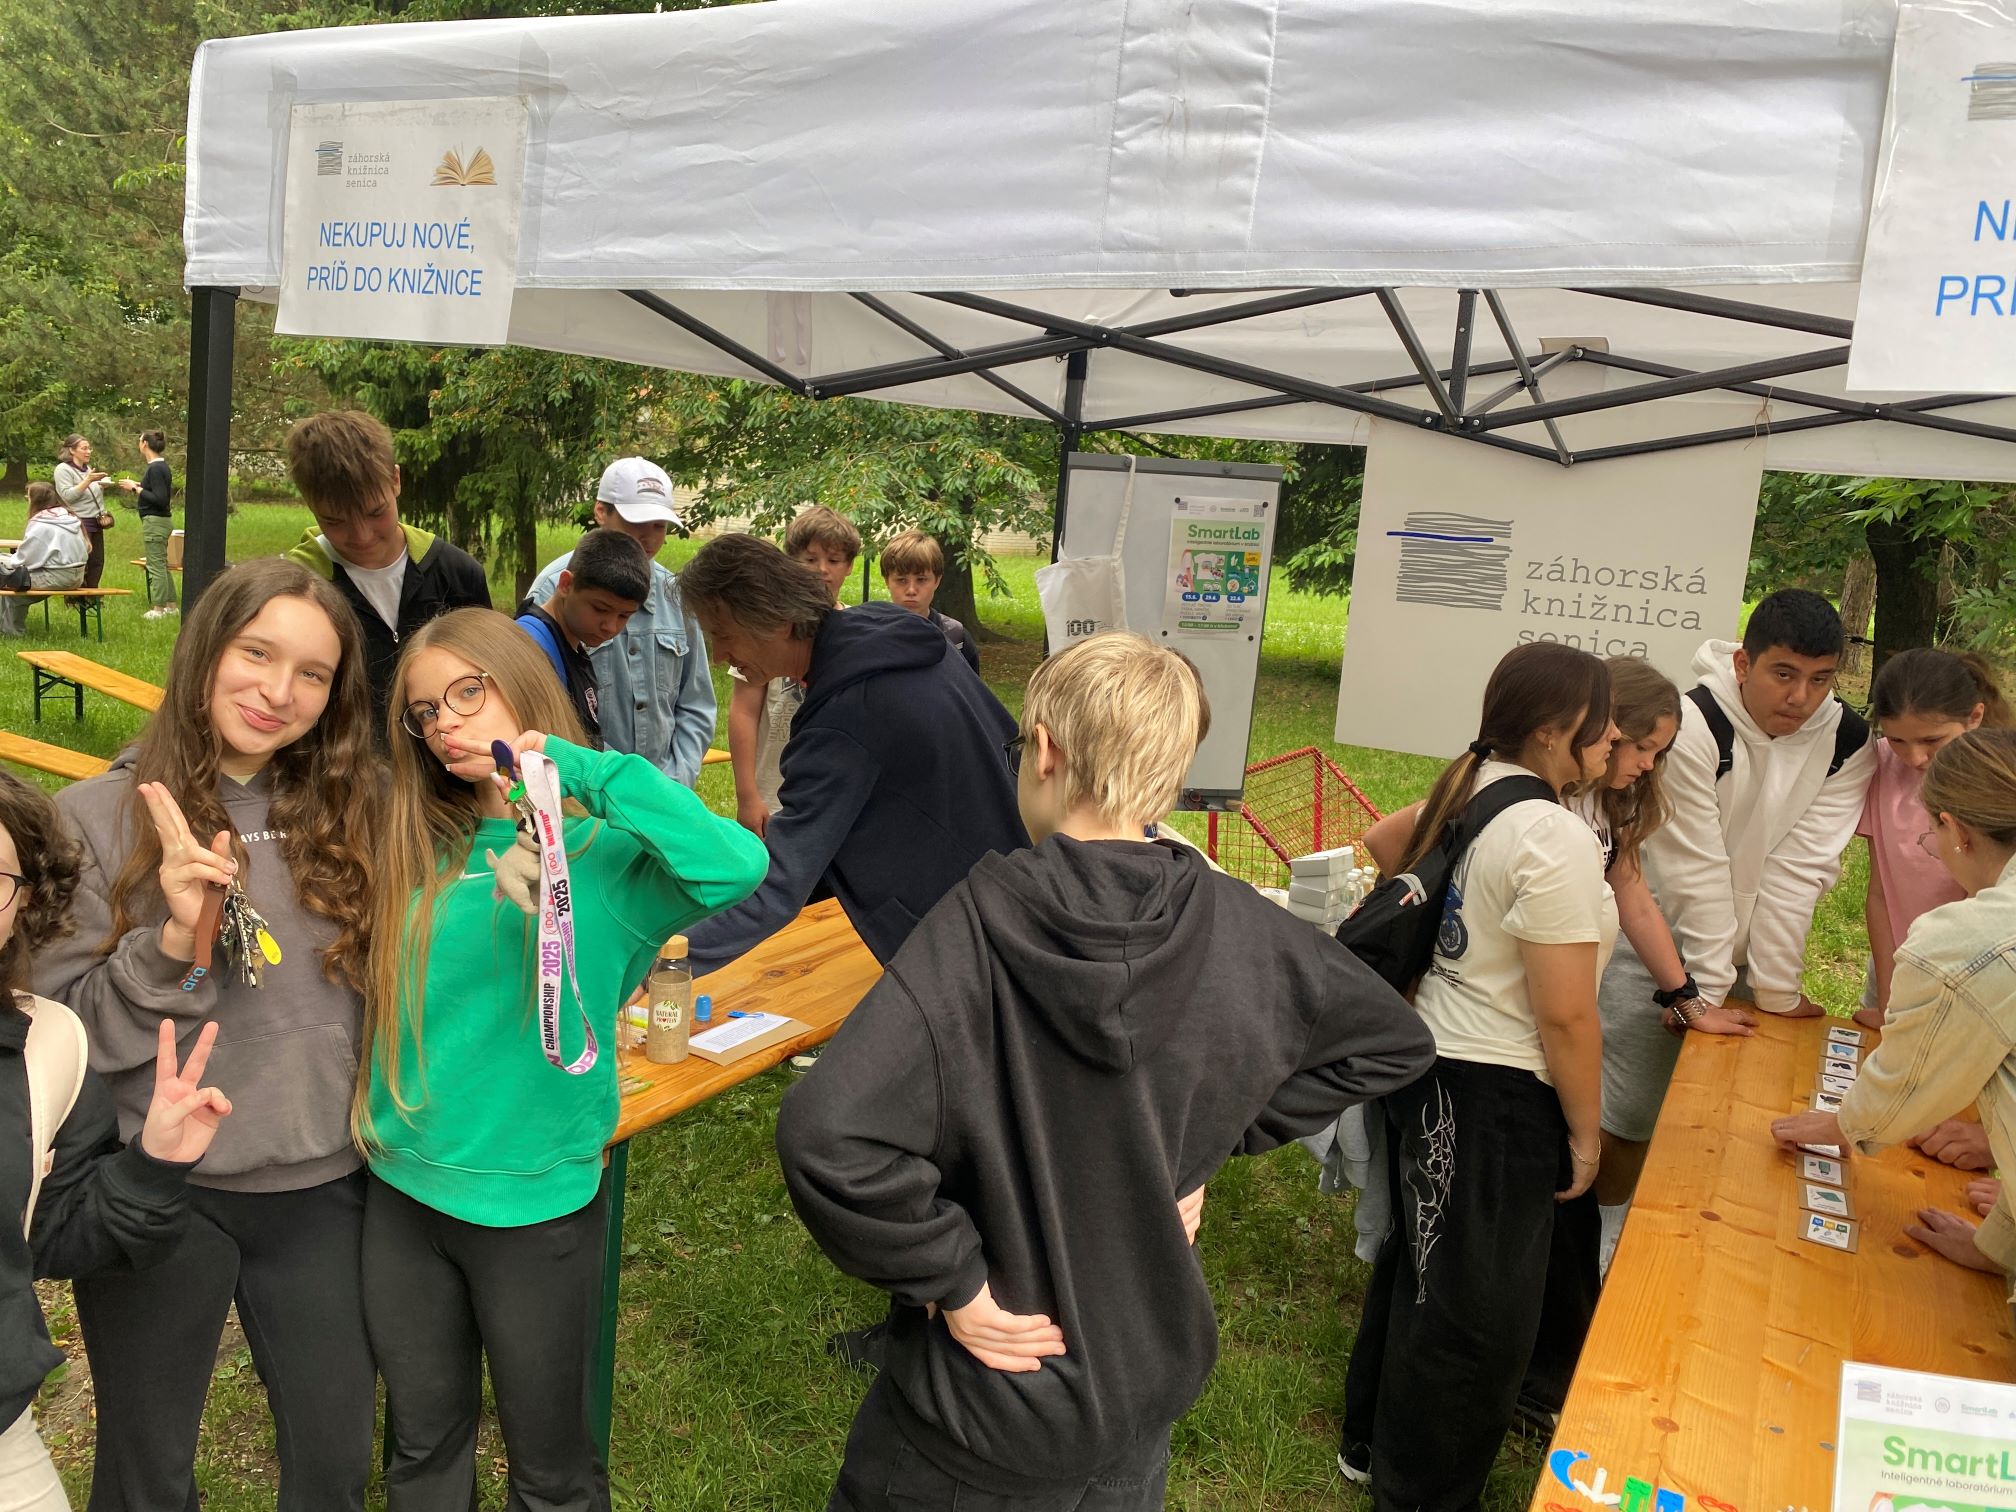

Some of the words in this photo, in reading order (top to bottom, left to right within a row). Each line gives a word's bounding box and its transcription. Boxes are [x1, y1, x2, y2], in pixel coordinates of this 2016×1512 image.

[347, 152, 390, 163] záhorská
[347, 165, 389, 175] knižnica
[345, 177, 377, 188] senica
[319, 222, 405, 248] NEKUPUJ
[413, 217, 474, 253] NOVÉ,
[1974, 199, 2016, 241] N
[306, 260, 348, 291] PRÍĎ
[353, 266, 382, 292] DO
[387, 263, 483, 296] KNIŽNICE
[1188, 524, 1260, 541] SmartLab
[1526, 555, 1708, 595] záhorská
[1521, 589, 1702, 630] knižnica
[552, 879, 570, 917] 2025
[542, 940, 560, 977] 2025
[543, 983, 555, 1050] CHAMPIONSHIP
[1881, 1470, 1943, 1486] Inteligentné
[1945, 1479, 2013, 1495] laboratórium
